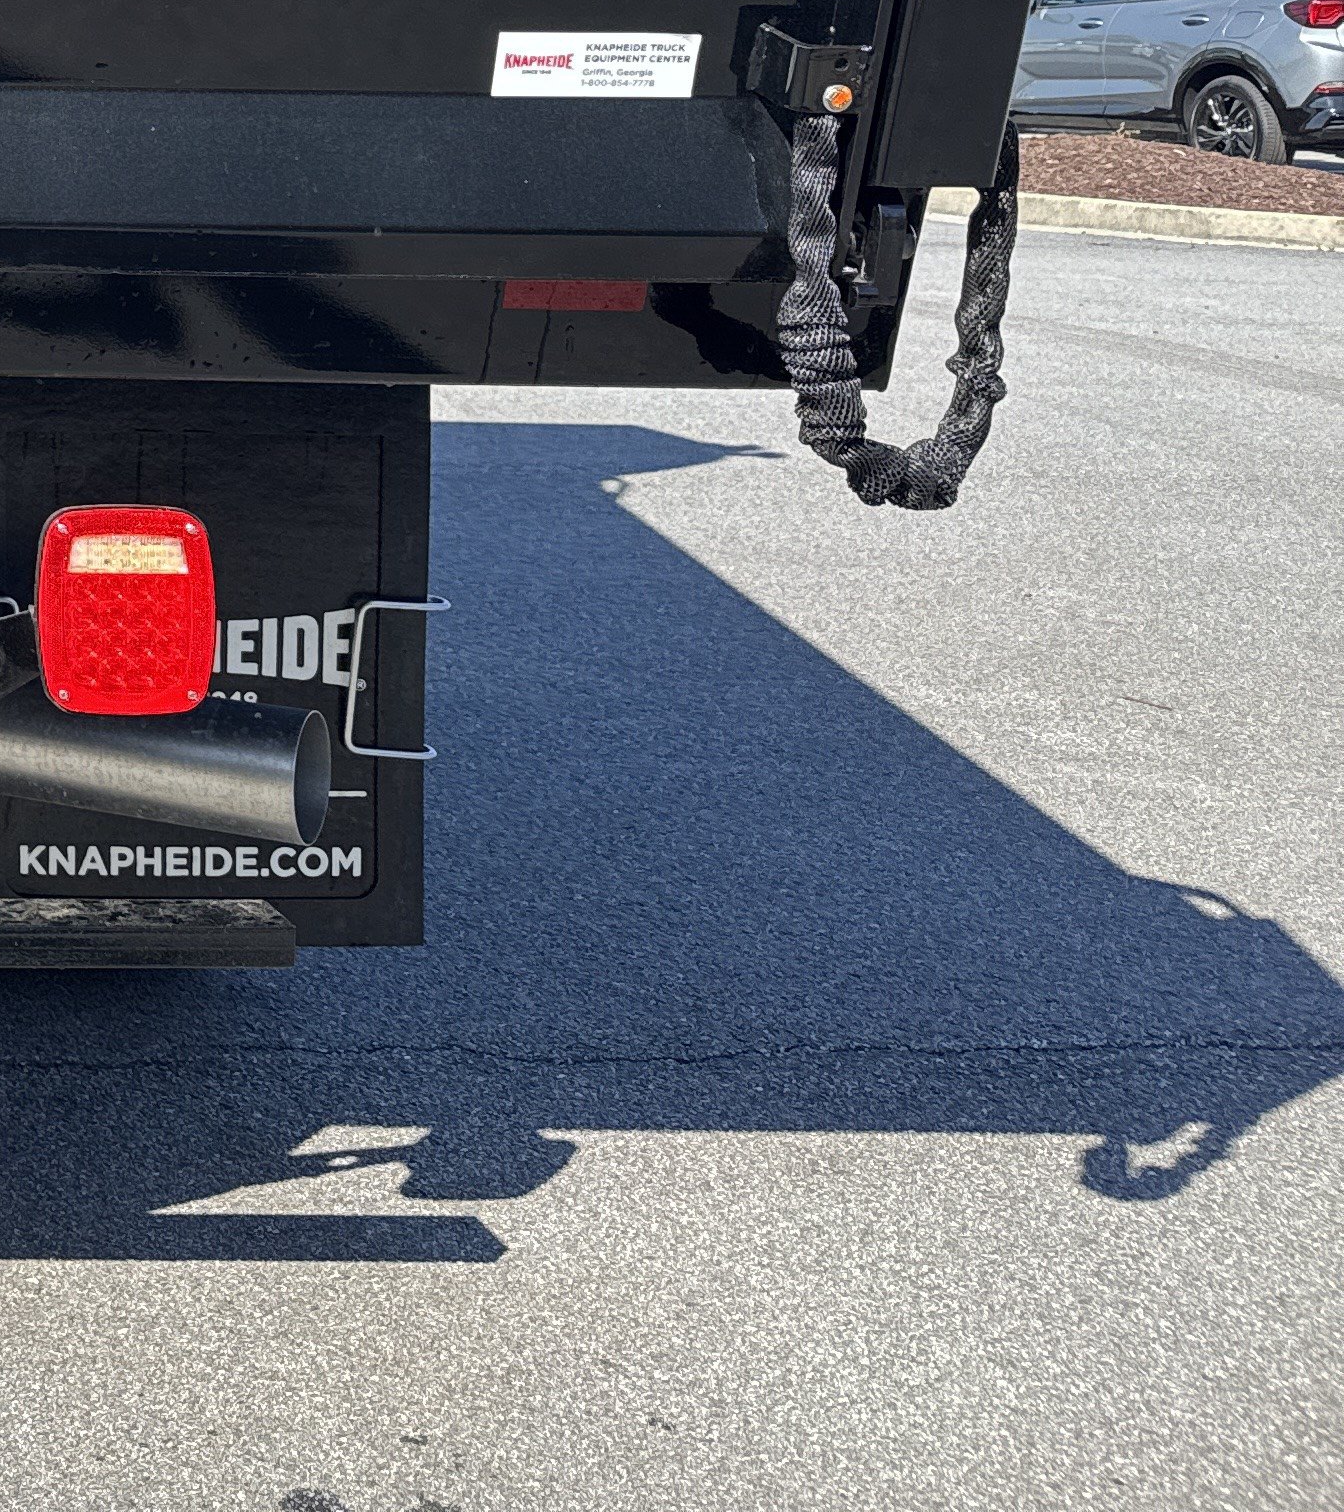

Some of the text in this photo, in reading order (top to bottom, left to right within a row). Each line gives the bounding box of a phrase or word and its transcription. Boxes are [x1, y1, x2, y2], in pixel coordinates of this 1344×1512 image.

[651, 44, 685, 52] TRUCK
[504, 53, 574, 69] KNAPHEIDE
[584, 55, 690, 63] EQUIPMENT CENTER
[617, 69, 653, 77] Georgia
[213, 608, 356, 687] EIDE
[19, 844, 363, 877] KNAPHEIDE.COM
